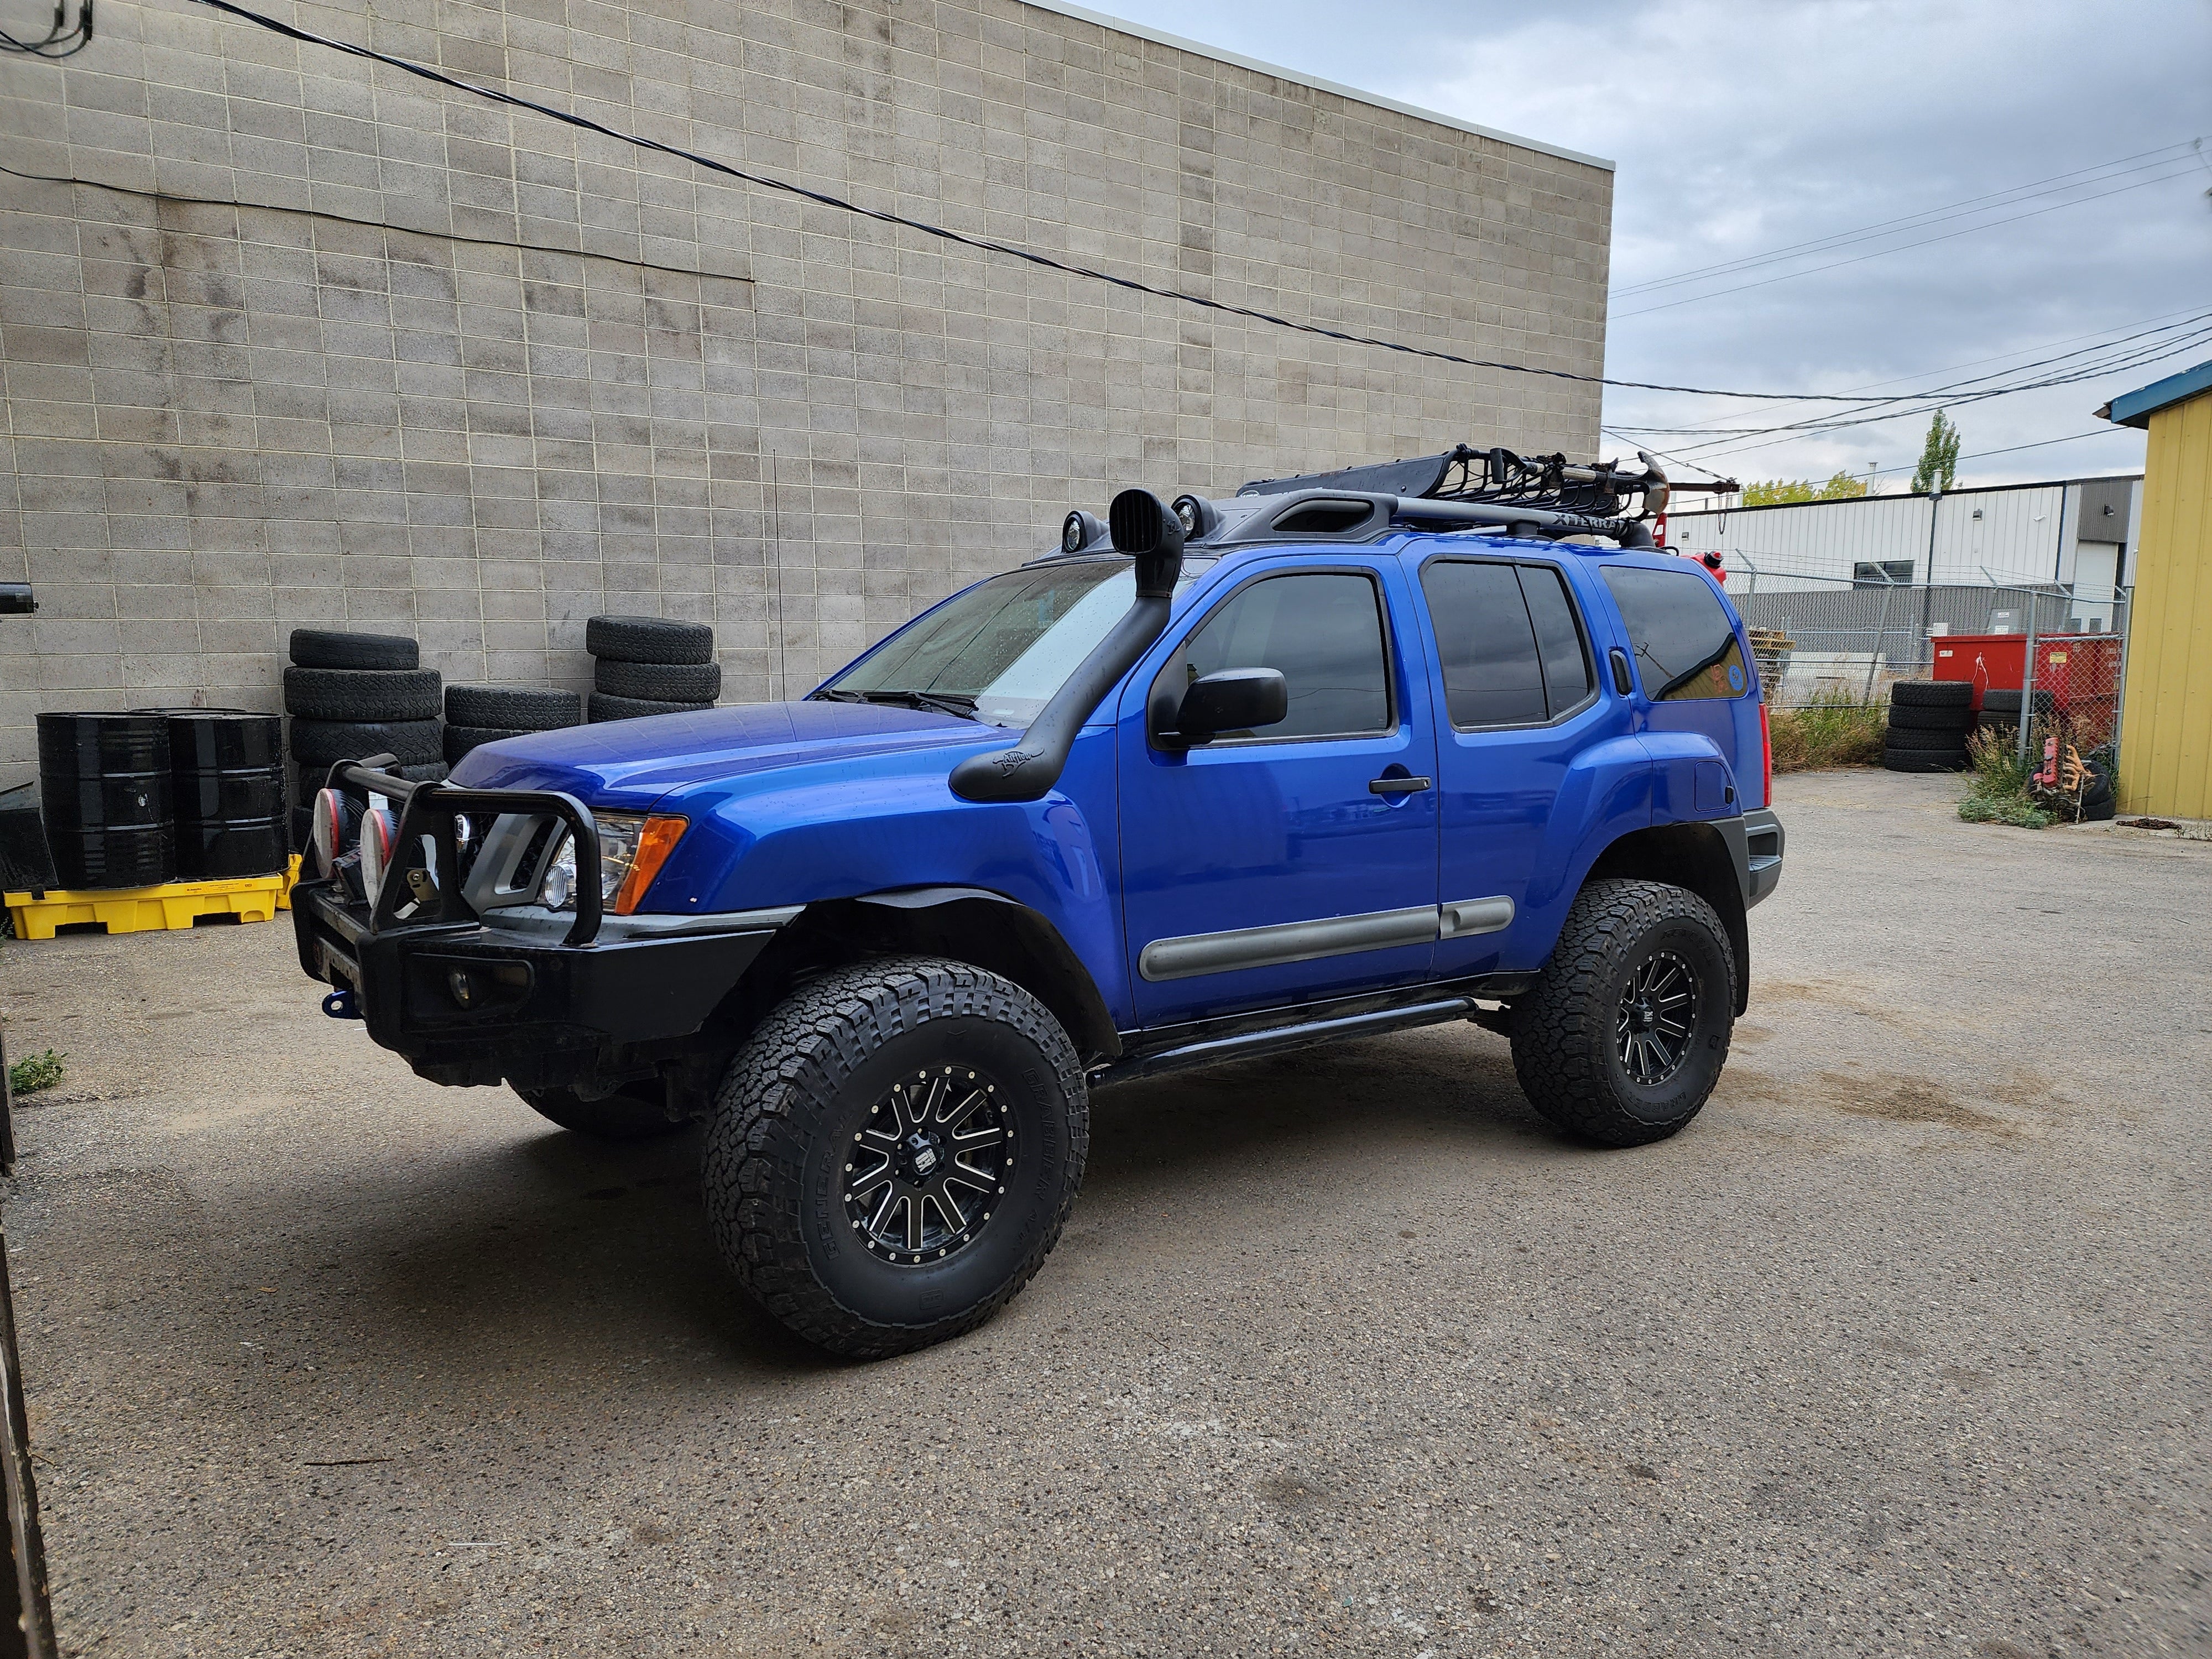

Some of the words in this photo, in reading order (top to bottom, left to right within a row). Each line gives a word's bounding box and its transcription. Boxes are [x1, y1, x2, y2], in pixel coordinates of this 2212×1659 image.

[1552, 513, 1616, 530] XTERRA
[1003, 752, 1031, 764] Airflow
[1627, 1090, 1687, 1113] GRABBER
[1021, 1066, 1056, 1201] GRABBER
[815, 1113, 853, 1260] GENERAL
